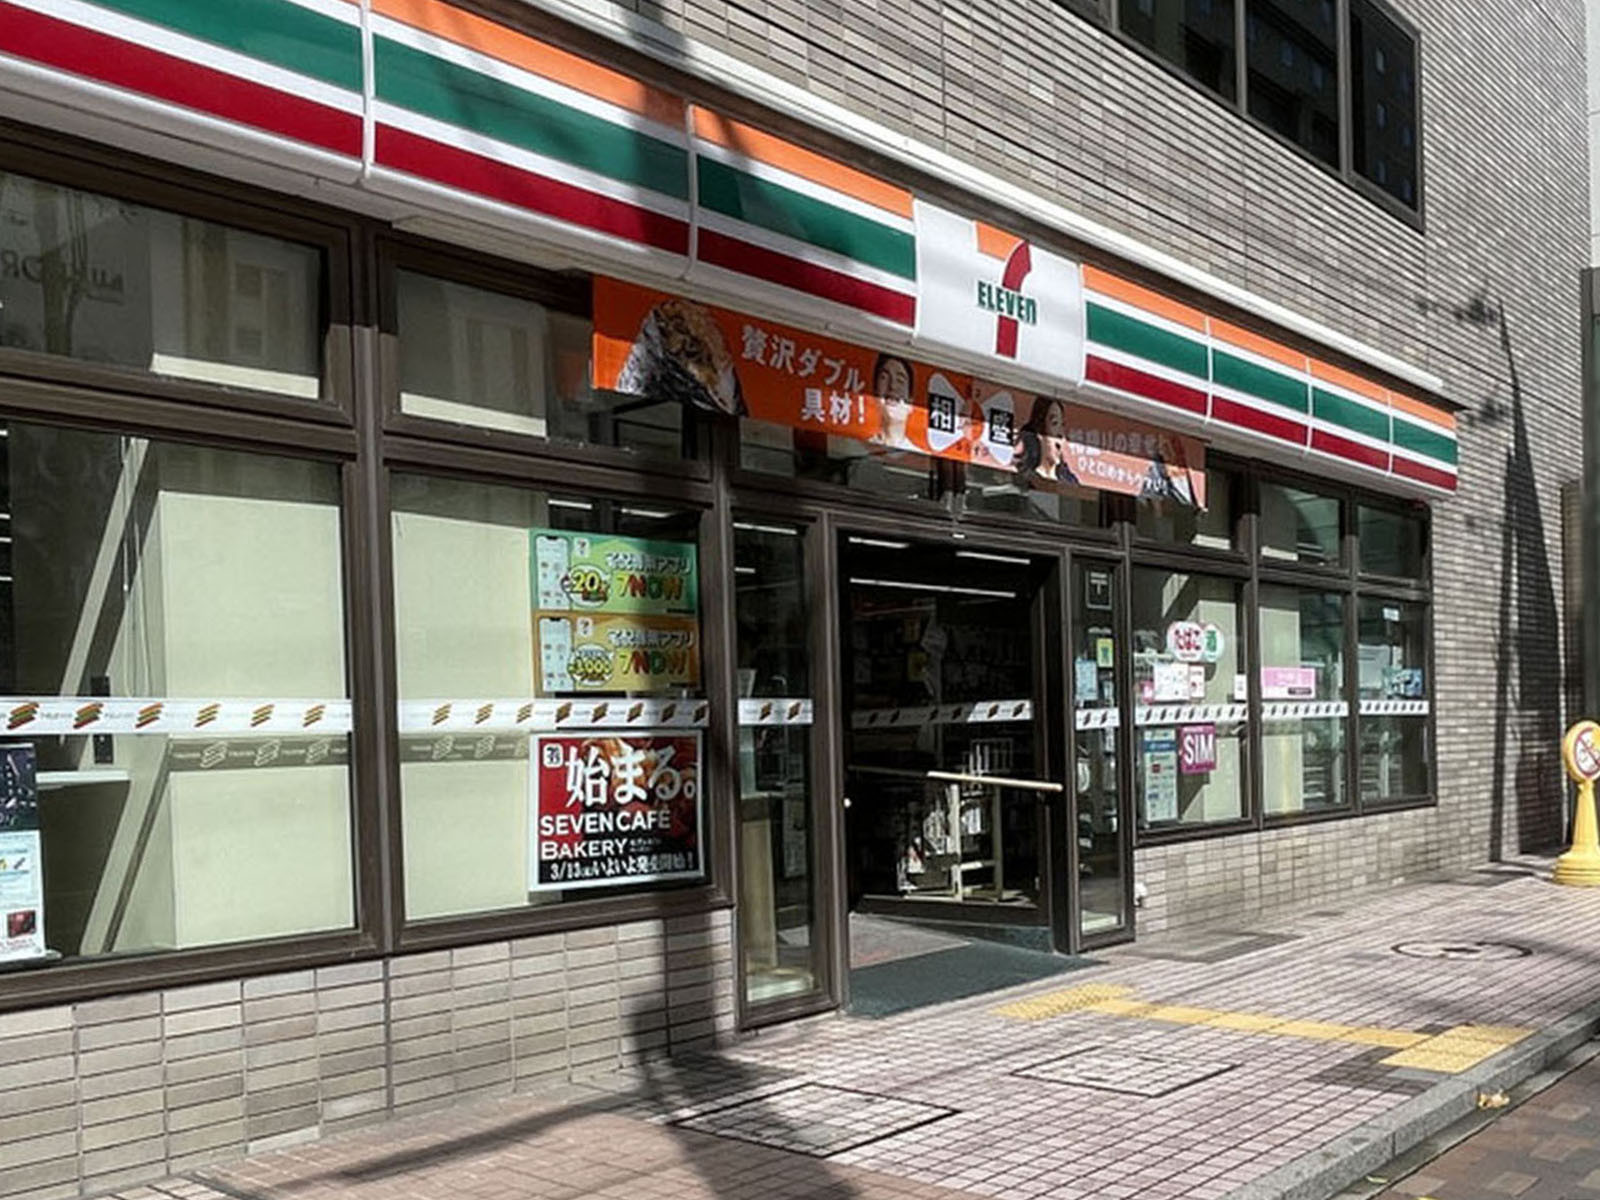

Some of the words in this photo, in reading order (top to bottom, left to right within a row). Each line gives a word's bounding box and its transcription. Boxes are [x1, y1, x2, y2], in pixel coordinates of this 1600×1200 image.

[741, 324, 866, 394] 贅沢ダブル
[1183, 733, 1216, 765] SIM
[564, 744, 697, 808] 始まる。
[540, 812, 614, 836] SEVEN
[541, 838, 628, 860] BAKERY
